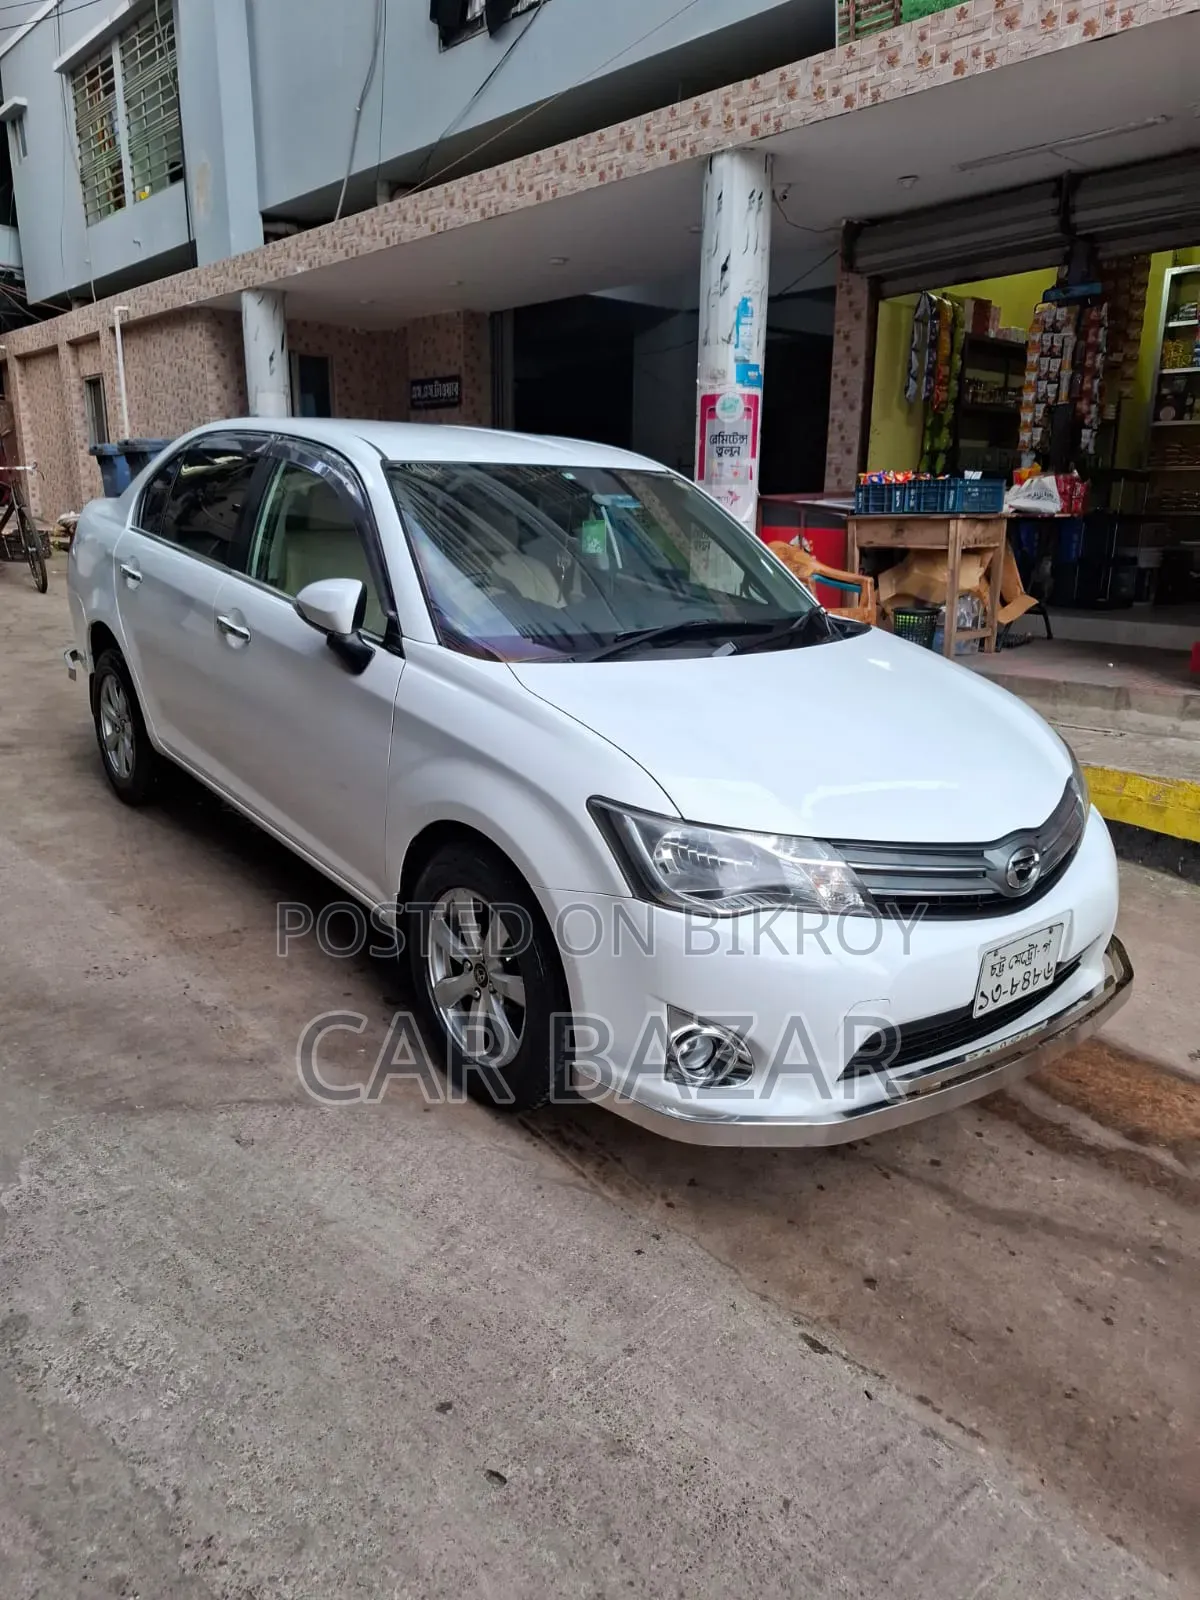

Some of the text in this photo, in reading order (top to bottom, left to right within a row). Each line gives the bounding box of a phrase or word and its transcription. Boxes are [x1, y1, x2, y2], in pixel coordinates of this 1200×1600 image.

[709, 431, 748, 446] রেমিটেন্স
[716, 446, 741, 458] তুলুন
[978, 962, 1053, 1009] ১৩-৮৪৮৬
